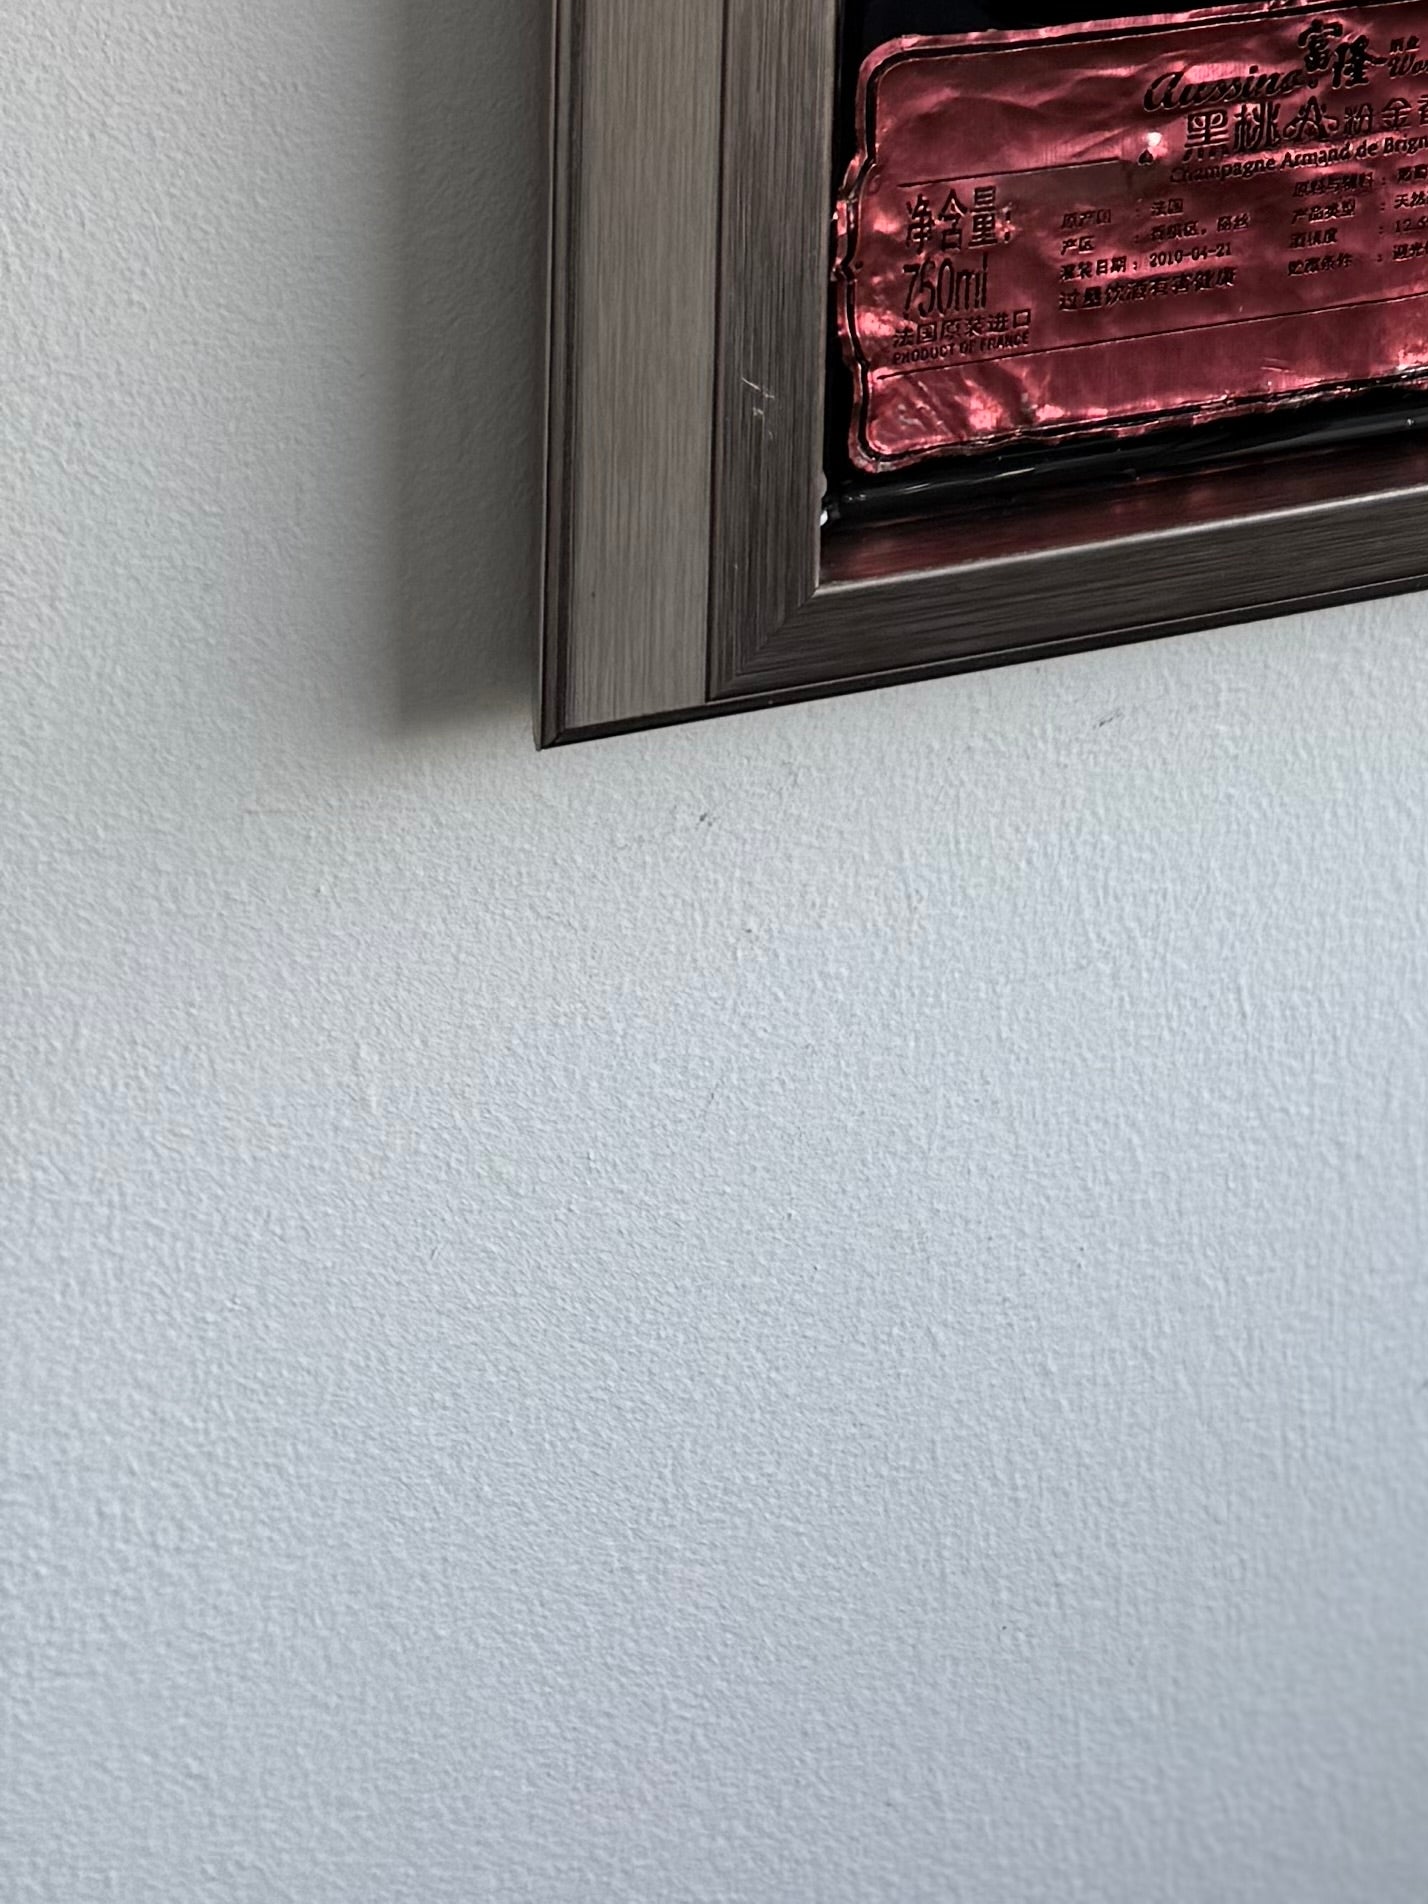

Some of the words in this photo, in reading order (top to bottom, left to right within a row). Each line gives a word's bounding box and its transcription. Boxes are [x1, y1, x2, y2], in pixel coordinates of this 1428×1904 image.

[1168, 156, 1276, 185] Champagne
[1277, 139, 1353, 171] Armand
[1355, 136, 1379, 158] de
[902, 253, 988, 319] 750ml
[892, 308, 1032, 347] 法国原装进口
[892, 342, 955, 365] PRODUCT
[960, 341, 976, 354] OF
[980, 331, 1030, 353] FRANCE
